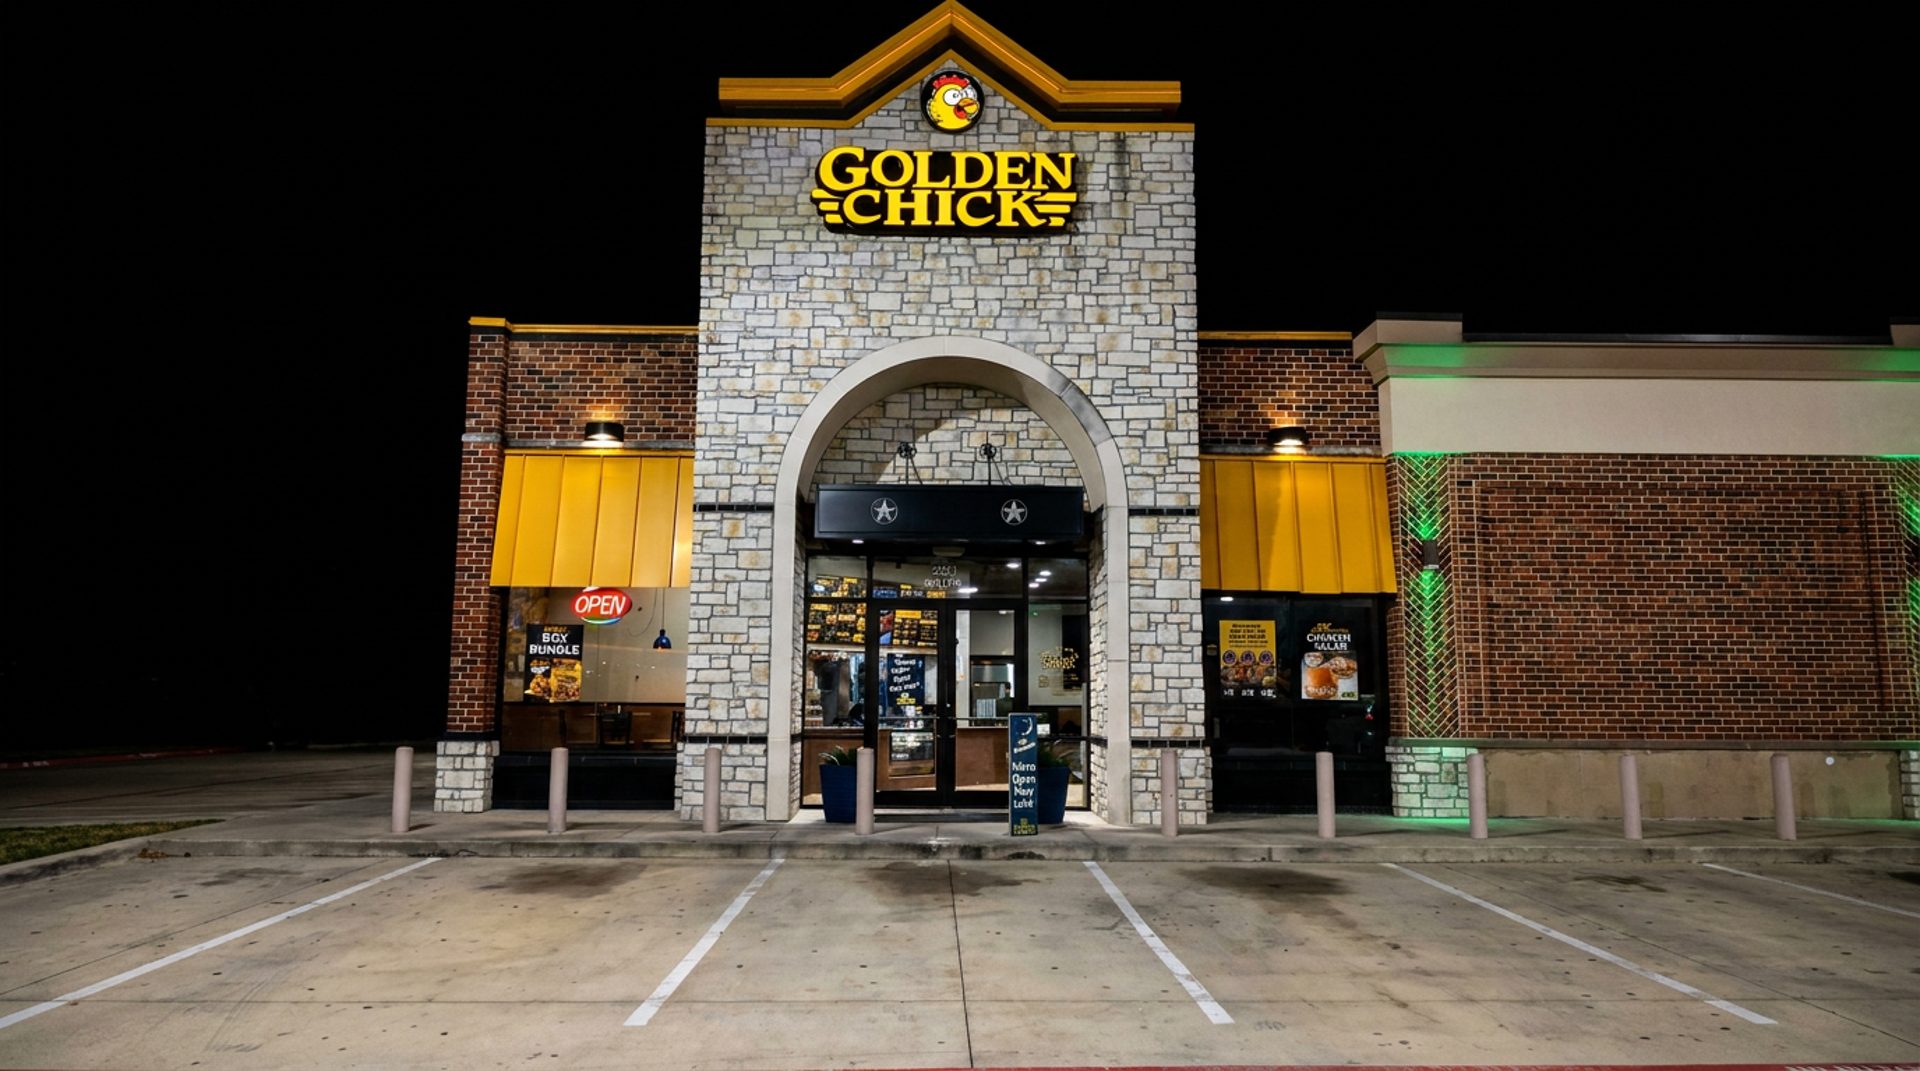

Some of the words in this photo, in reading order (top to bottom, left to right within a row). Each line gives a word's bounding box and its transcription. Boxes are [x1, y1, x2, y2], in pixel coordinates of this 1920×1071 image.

[818, 146, 1077, 191] GOLDEN
[843, 188, 1047, 228] CHICK
[575, 595, 626, 615] OPEN
